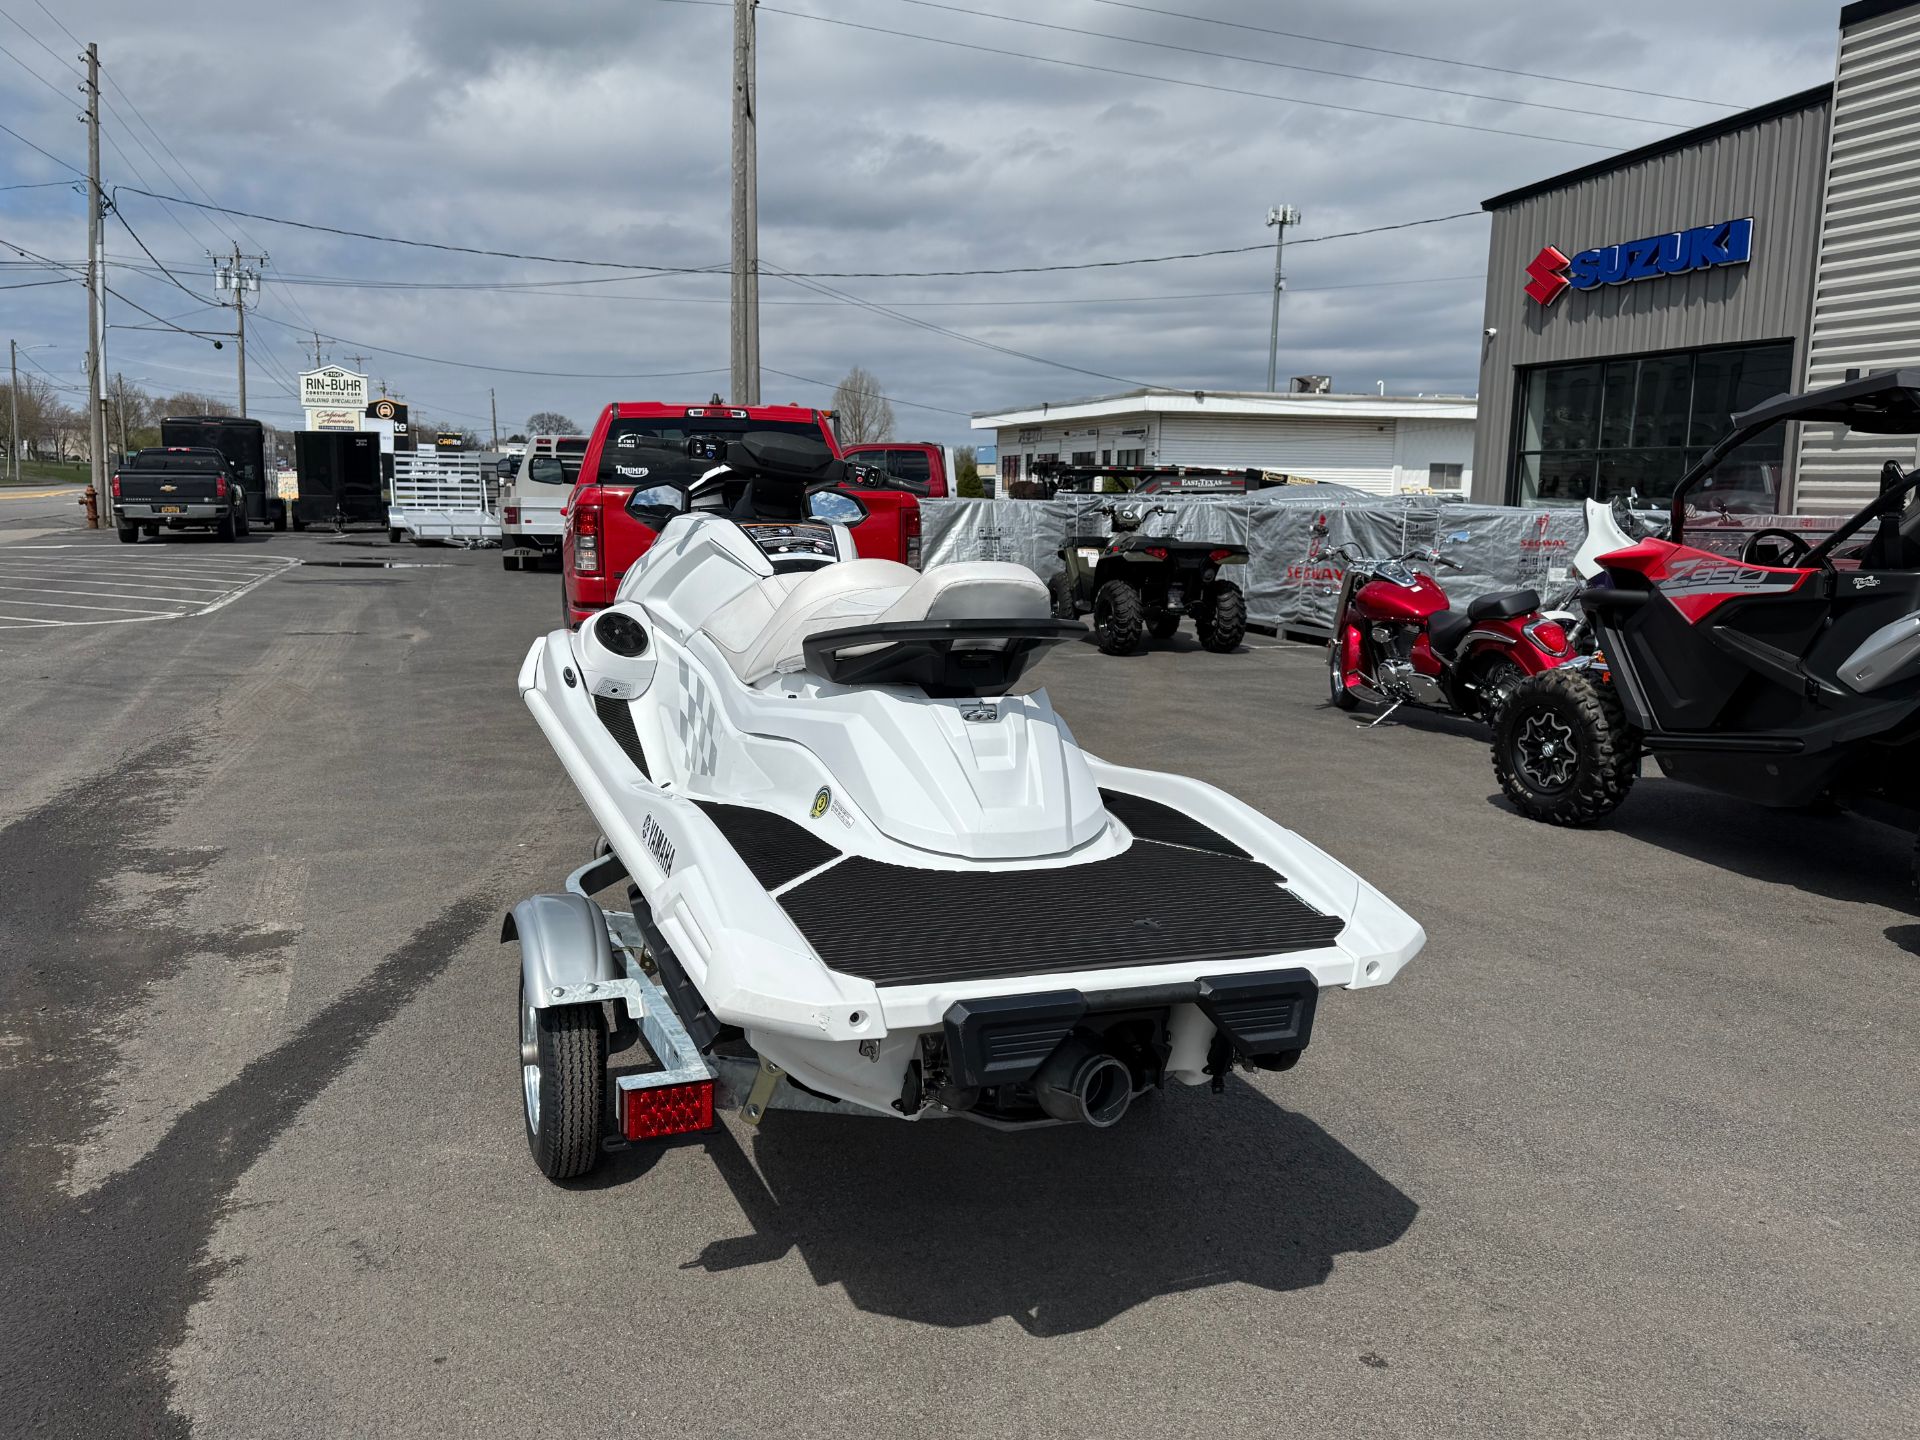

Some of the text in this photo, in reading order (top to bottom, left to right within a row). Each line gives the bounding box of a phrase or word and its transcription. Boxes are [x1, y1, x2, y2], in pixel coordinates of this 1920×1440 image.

[1570, 217, 1754, 291] SUZUKI
[306, 378, 362, 392] RIN-BUHR
[615, 465, 650, 478] TRIUMPH
[1181, 479, 1200, 487] EAST
[1199, 479, 1223, 488] TEXAS
[1520, 539, 1568, 547] SEGWAY
[1287, 565, 1345, 581] SEGWAY
[647, 818, 676, 879] YAMAHA
